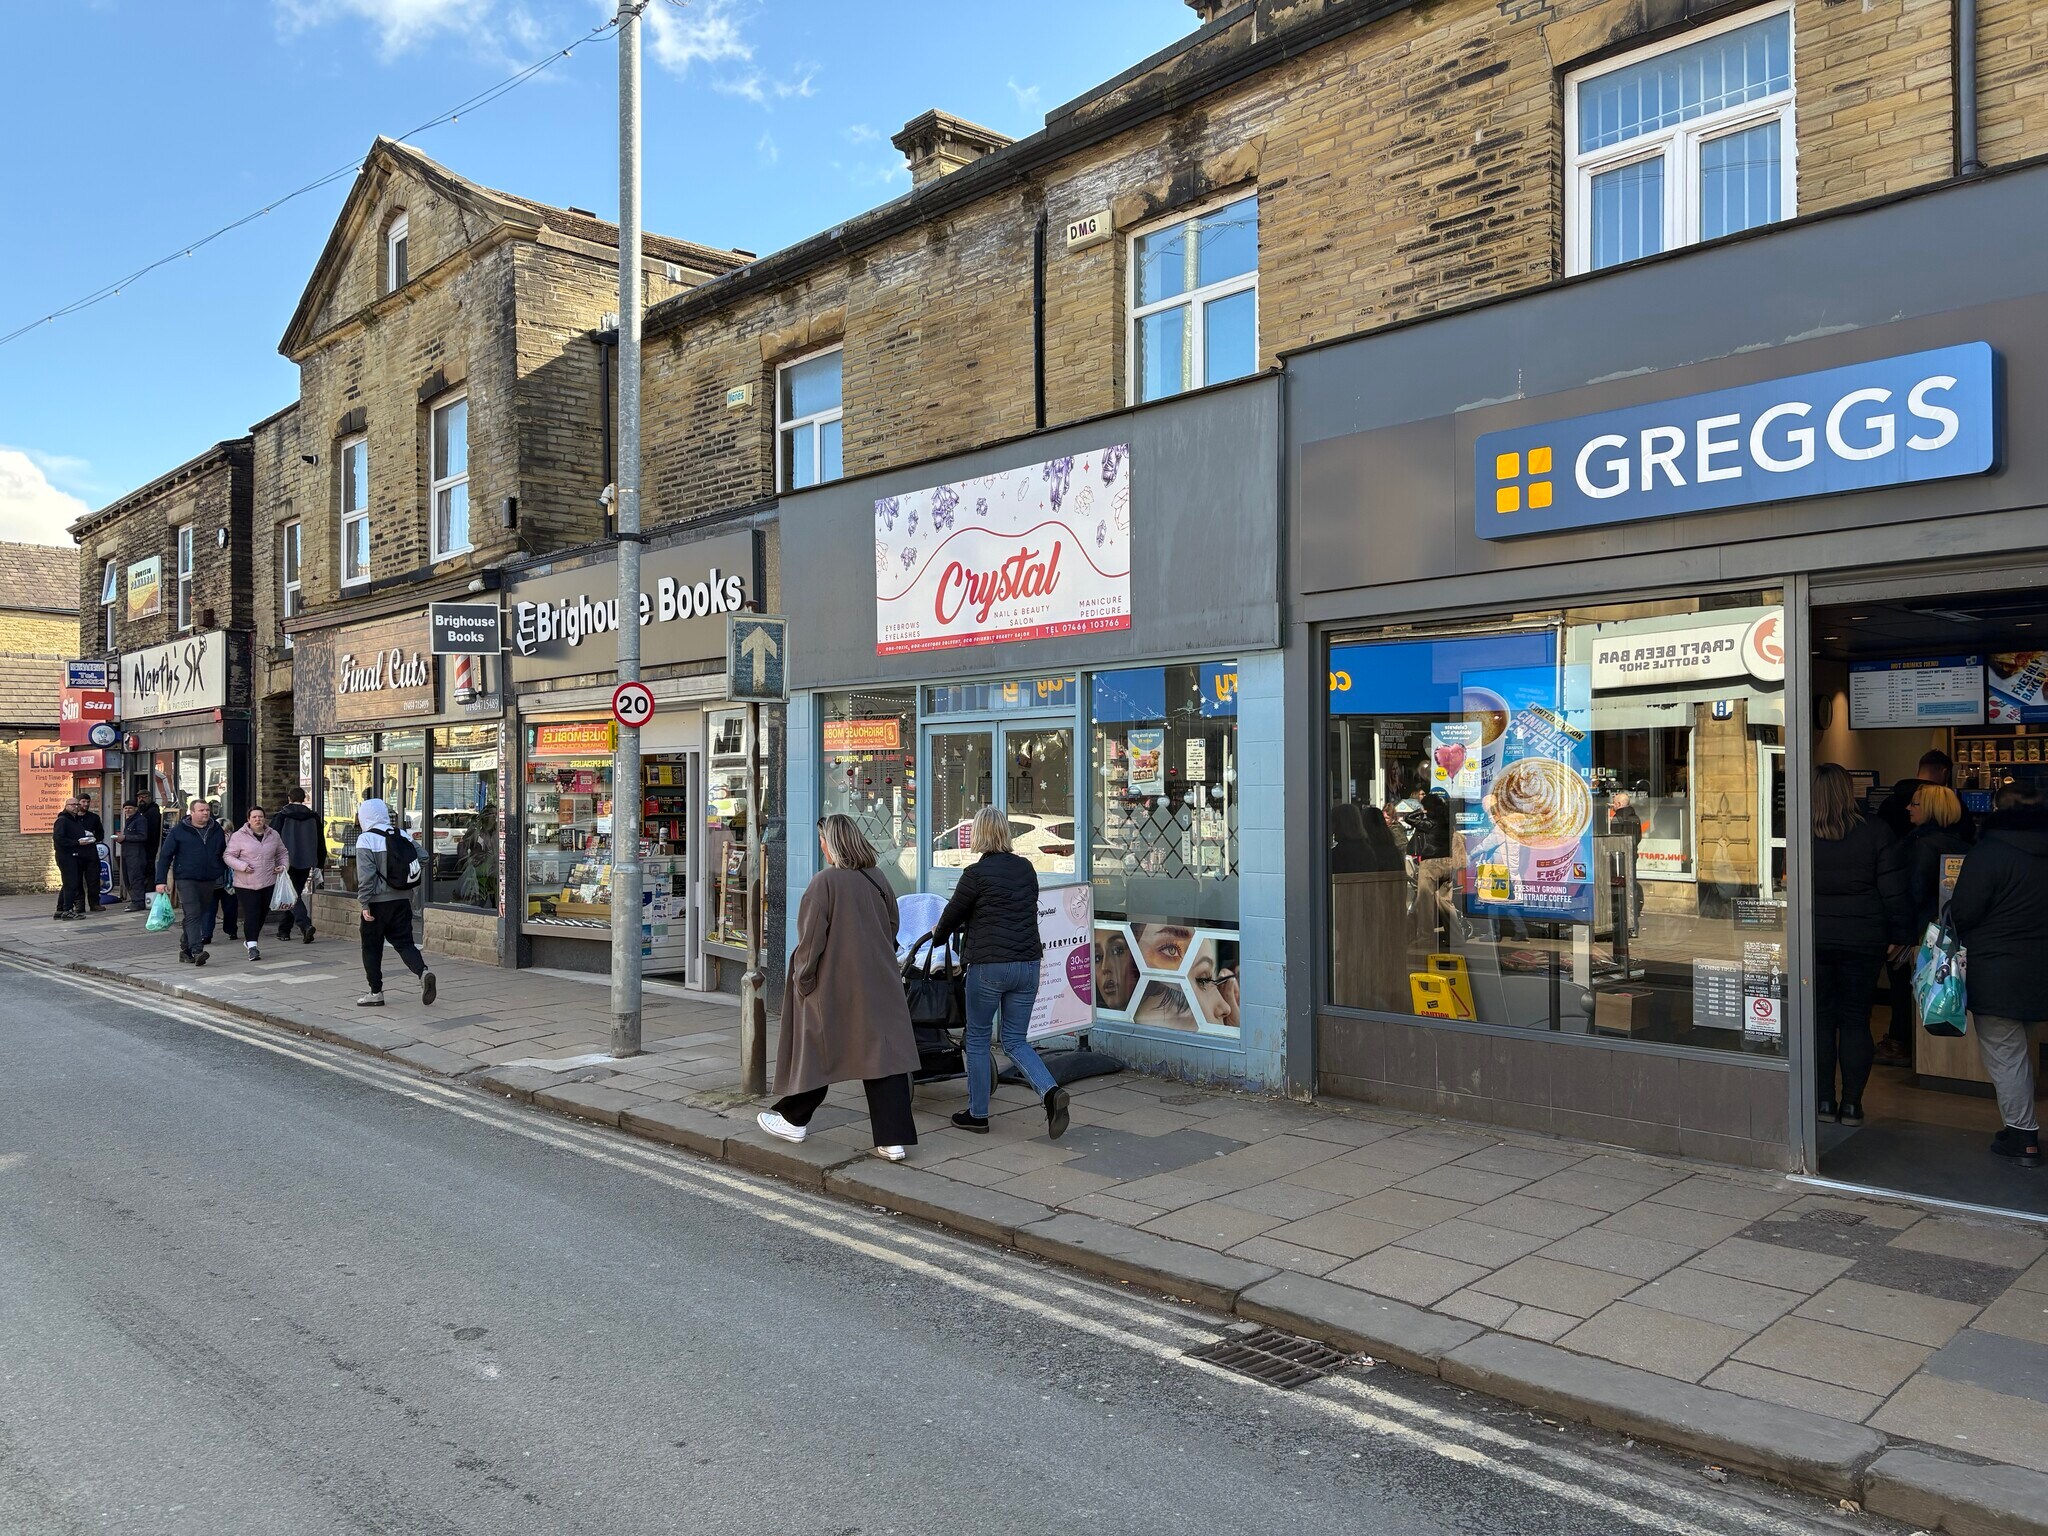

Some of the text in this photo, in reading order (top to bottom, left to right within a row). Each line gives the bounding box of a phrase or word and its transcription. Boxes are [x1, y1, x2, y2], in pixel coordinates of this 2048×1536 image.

[1574, 375, 1960, 500] GREGGS
[935, 540, 1062, 625] Crystal
[537, 567, 743, 647] Brighoue Books
[1079, 595, 1122, 608] MANICURE
[993, 610, 1010, 618] NAIL
[1021, 605, 1050, 615] BEAUTY
[1080, 606, 1121, 618] PEDICURE
[435, 614, 495, 628] Brighouse
[885, 621, 920, 632] EYEBROWS
[1009, 617, 1034, 627] SALON
[1045, 618, 1120, 634] TEL 07466 103766
[447, 631, 485, 642] Books
[885, 630, 921, 641] EYELASHES
[133, 646, 180, 701] North's
[338, 648, 428, 694] Final Cuts
[619, 695, 649, 714] 20
[1529, 702, 1555, 723] LIMITED
[1516, 710, 1578, 752] CINNAMON
[1514, 885, 1567, 895] FRESHLY GROUND
[1514, 893, 1572, 904] FAIRTRADE COFFEE
[1048, 935, 1087, 949] SERVICES
[1697, 964, 1720, 972] OPENING
